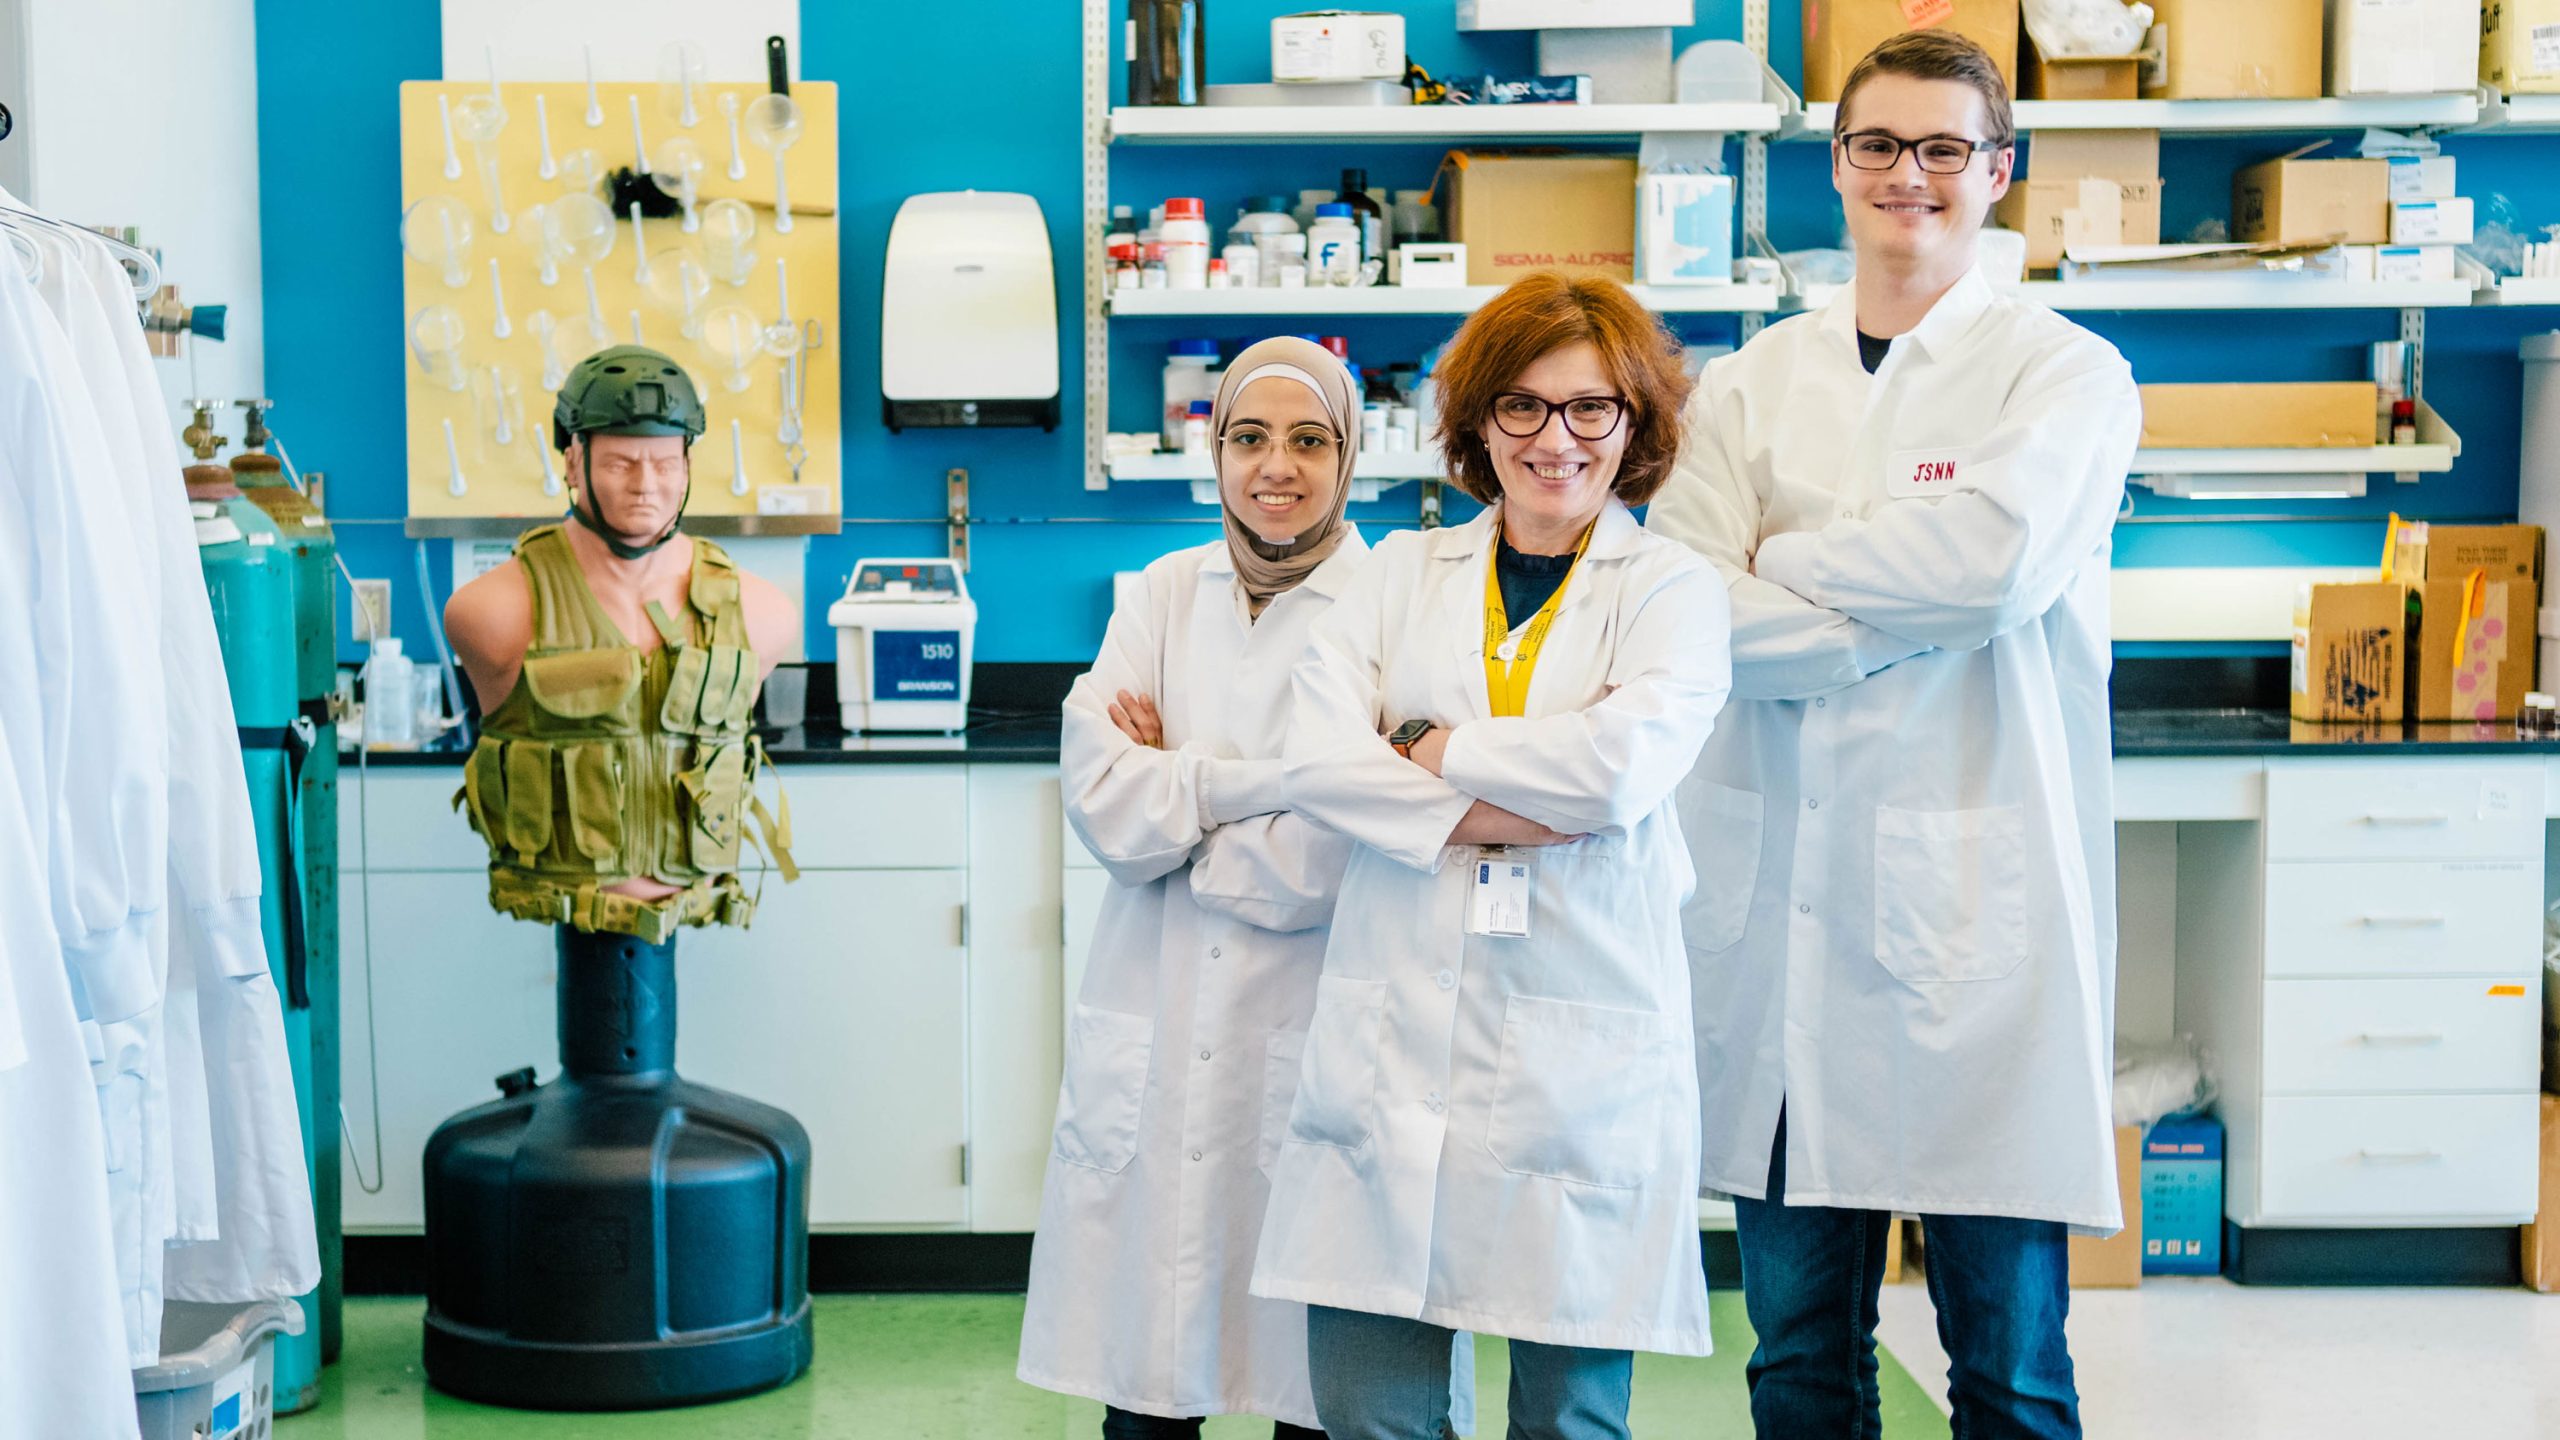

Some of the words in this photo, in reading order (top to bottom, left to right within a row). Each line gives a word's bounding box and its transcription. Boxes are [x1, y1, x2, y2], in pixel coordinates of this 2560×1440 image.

[1494, 253, 1634, 267] SIGMA-ALDRIC
[1913, 460, 1955, 482] JSNN
[921, 643, 954, 660] 1510
